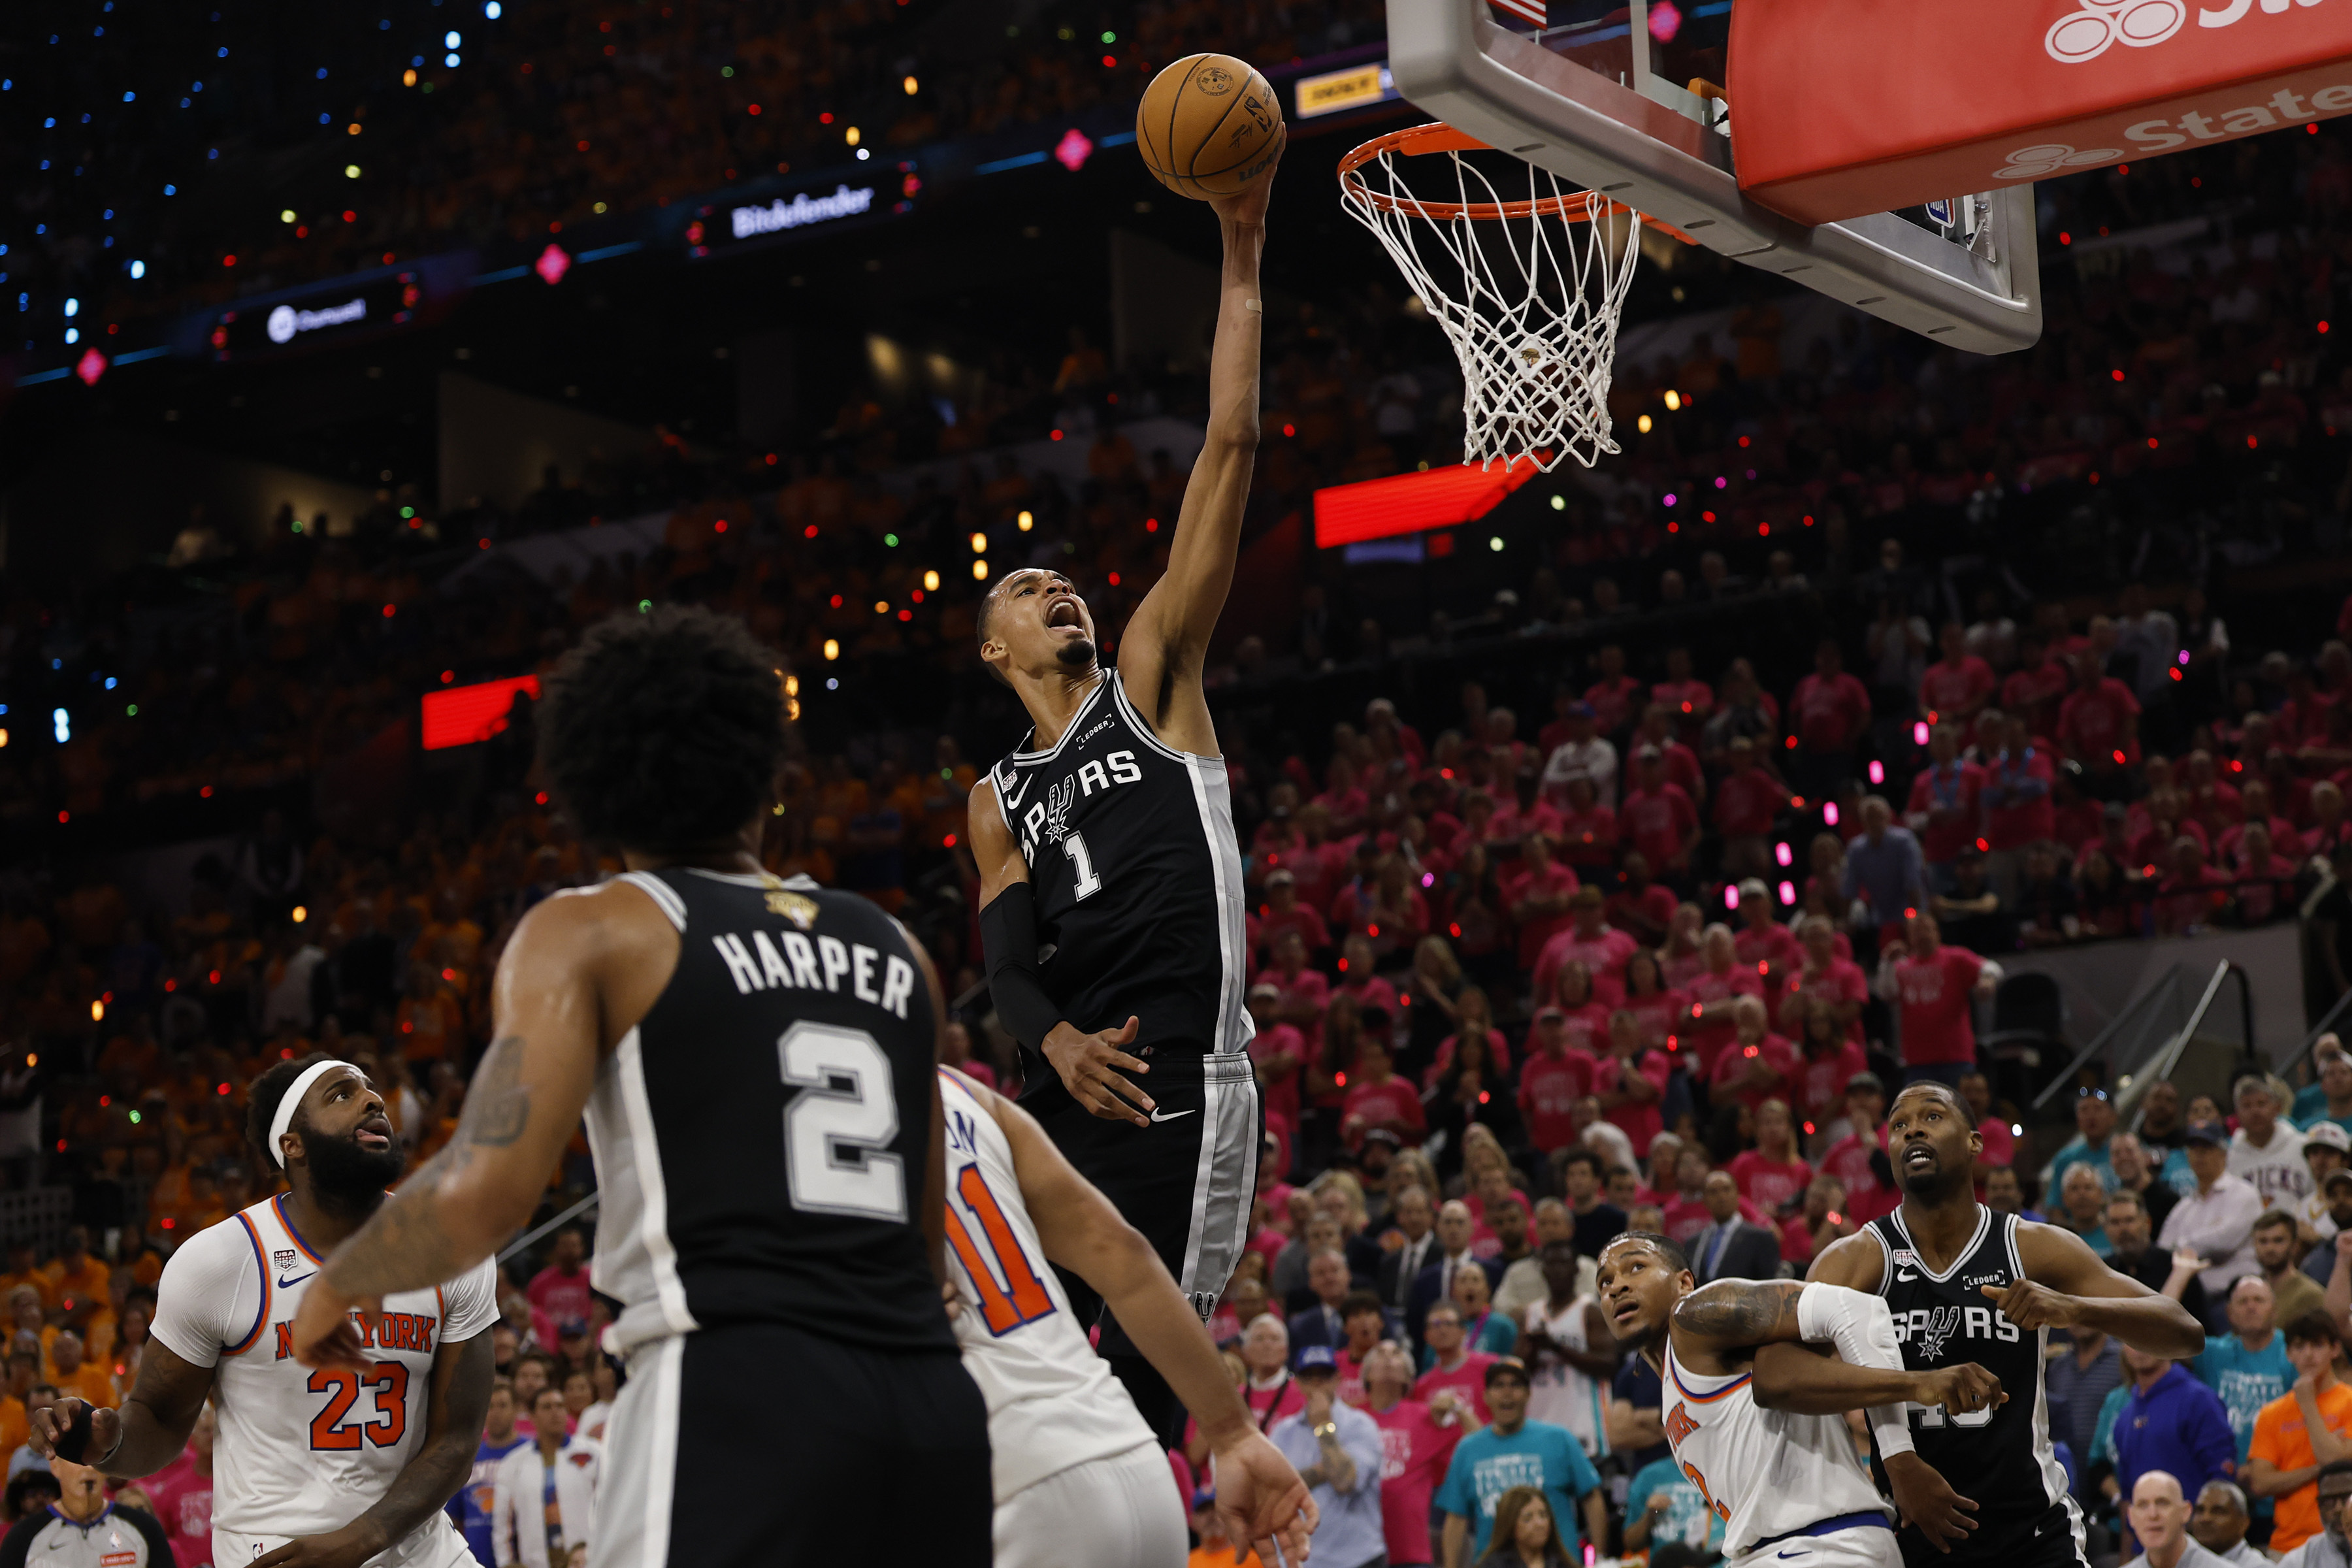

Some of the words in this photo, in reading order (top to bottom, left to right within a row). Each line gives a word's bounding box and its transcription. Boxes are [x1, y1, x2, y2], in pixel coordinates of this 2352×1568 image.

[2124, 84, 2352, 152] State
[731, 184, 875, 239] Bitdefender
[1081, 720, 1109, 743] LEDGER
[1021, 749, 1143, 870] SPURS
[1061, 830, 1102, 902] 1
[711, 929, 915, 1021] HARPER
[777, 1018, 909, 1224] 2
[1968, 1274, 2000, 1286] LEDGER
[1892, 1305, 2019, 1362] SPURS
[308, 1361, 410, 1450] 23
